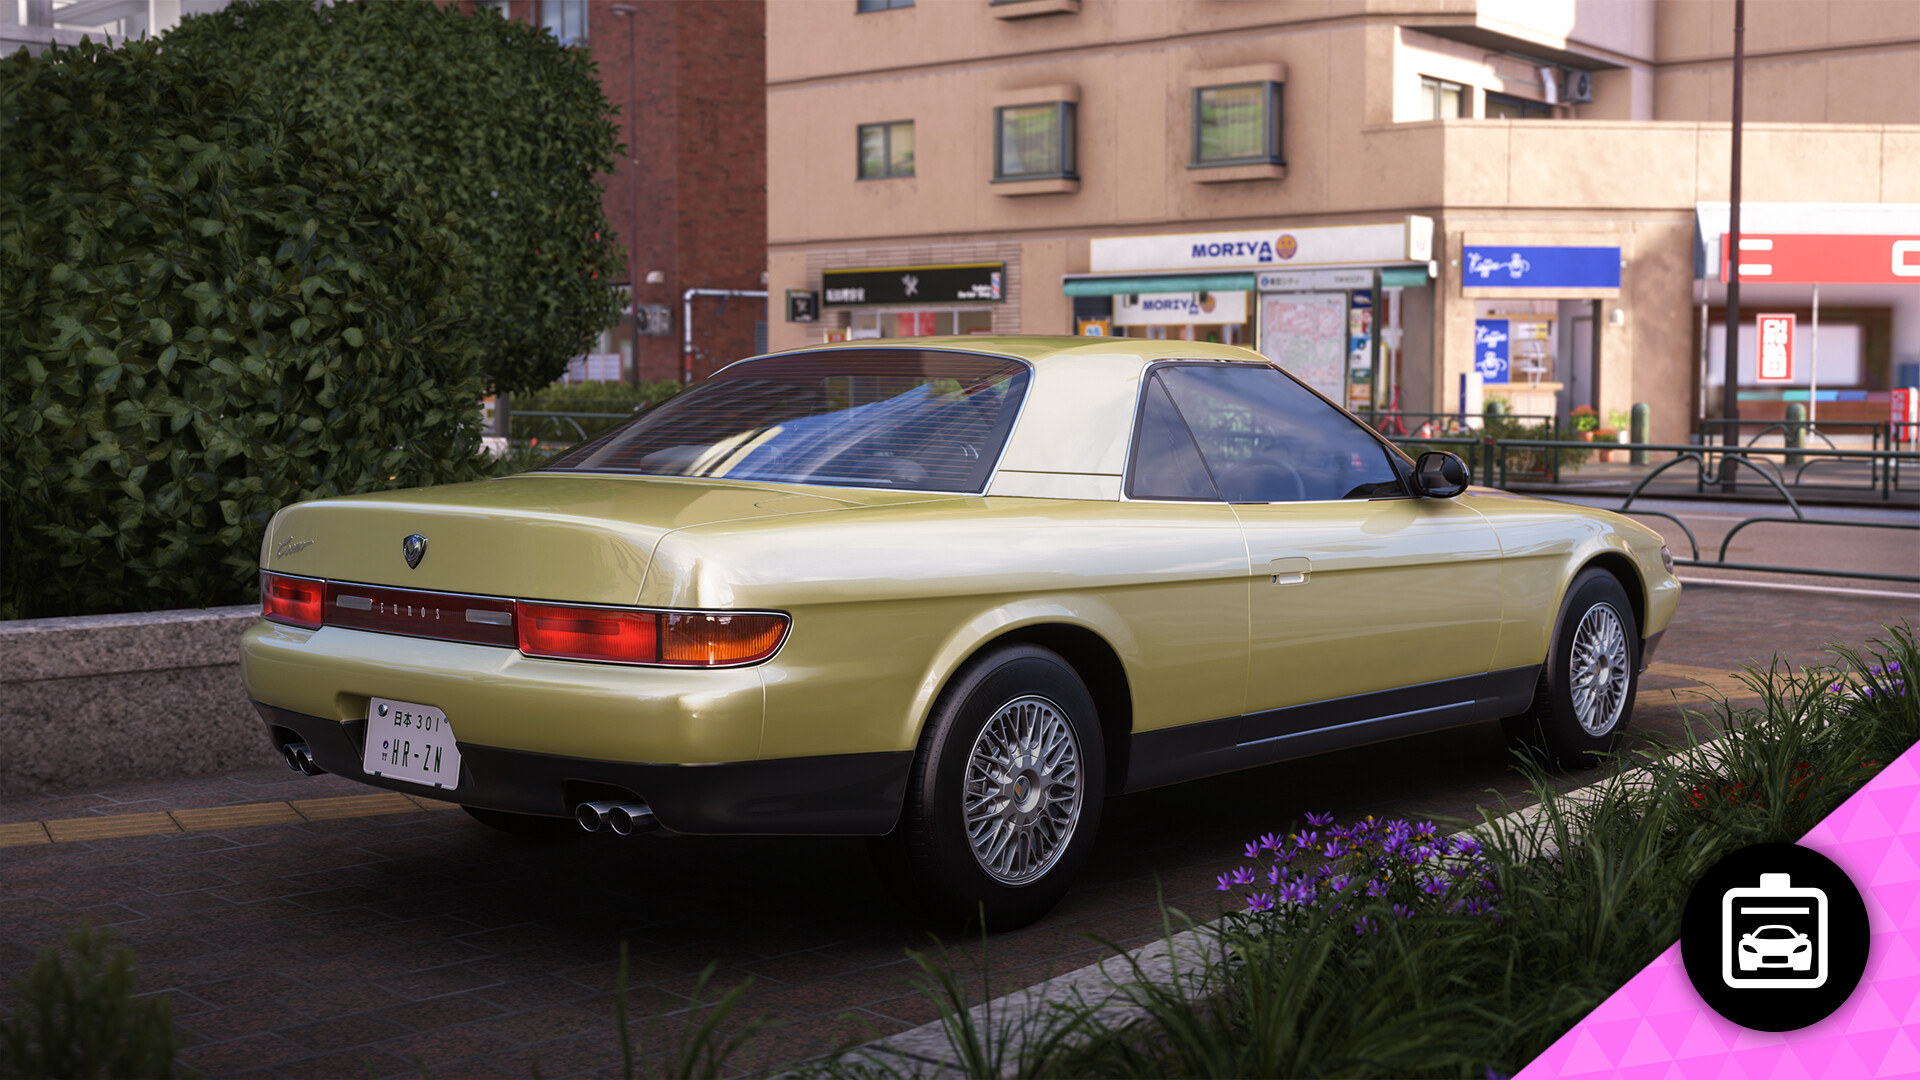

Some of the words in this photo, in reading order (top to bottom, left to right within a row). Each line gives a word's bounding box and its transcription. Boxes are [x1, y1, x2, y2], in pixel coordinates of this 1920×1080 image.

[1191, 241, 1273, 262] MORIYA
[1142, 299, 1199, 315] MORIYA
[394, 711, 412, 727] 日本
[416, 714, 439, 732] 301
[391, 739, 442, 773] HR-ZN
